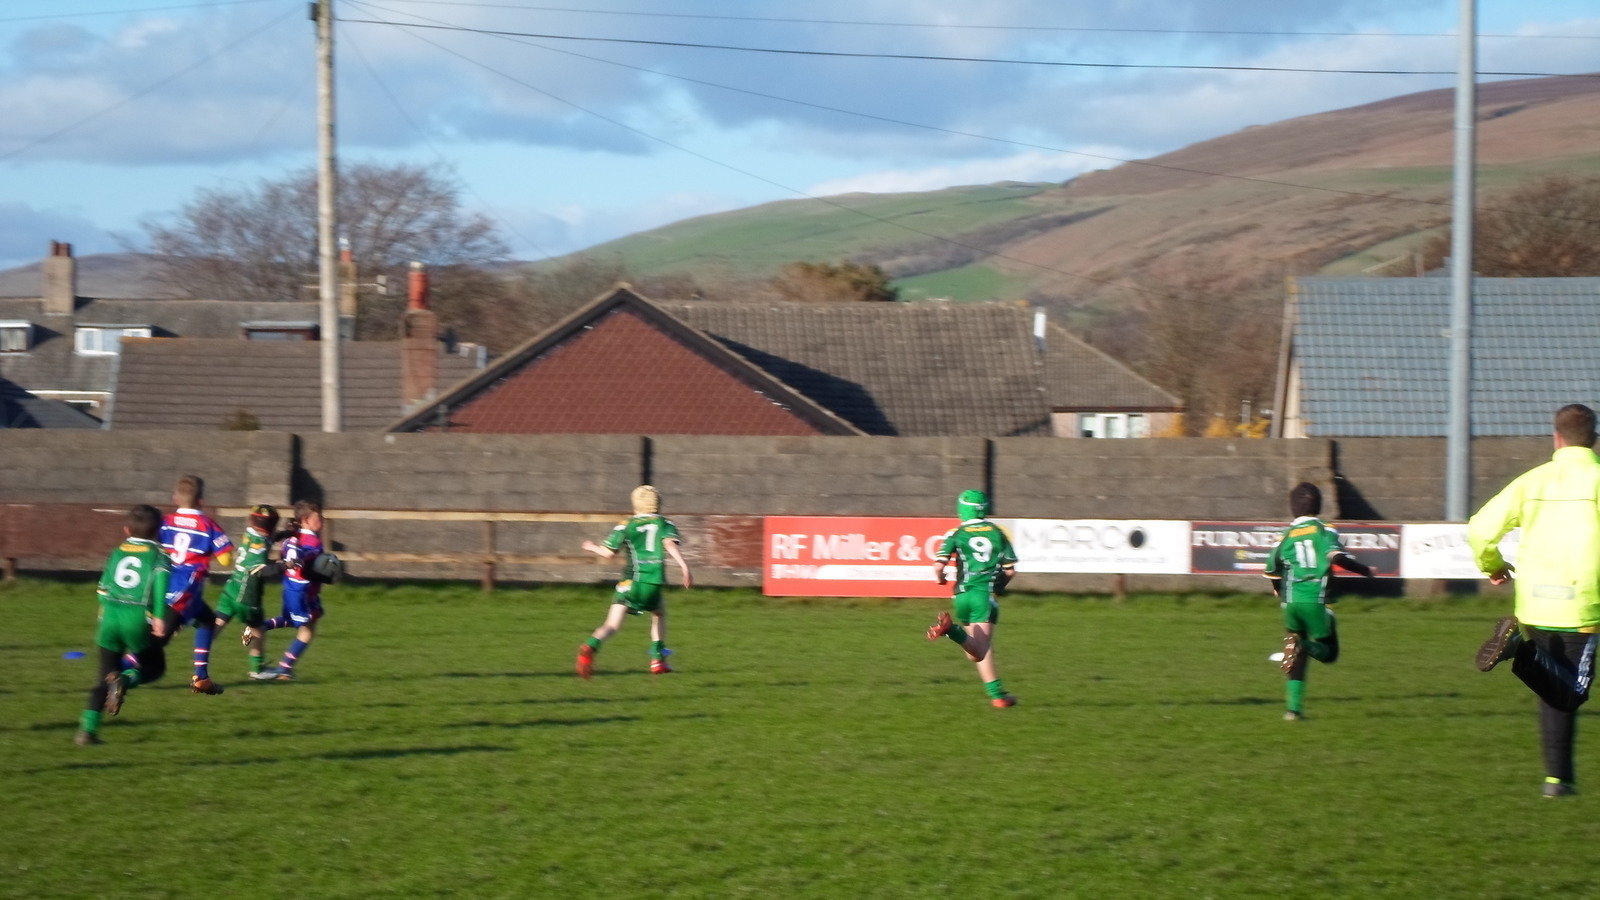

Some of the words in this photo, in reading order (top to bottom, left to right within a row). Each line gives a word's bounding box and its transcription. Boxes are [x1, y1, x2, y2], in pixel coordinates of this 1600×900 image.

[170, 533, 191, 564] 9
[636, 523, 659, 552] 7
[771, 533, 809, 560] RF
[812, 533, 895, 561] Miller
[897, 534, 922, 561] &
[968, 536, 993, 563] 9
[1193, 531, 1283, 547] FURNE
[1294, 539, 1317, 568] 11
[114, 556, 143, 589] 6
